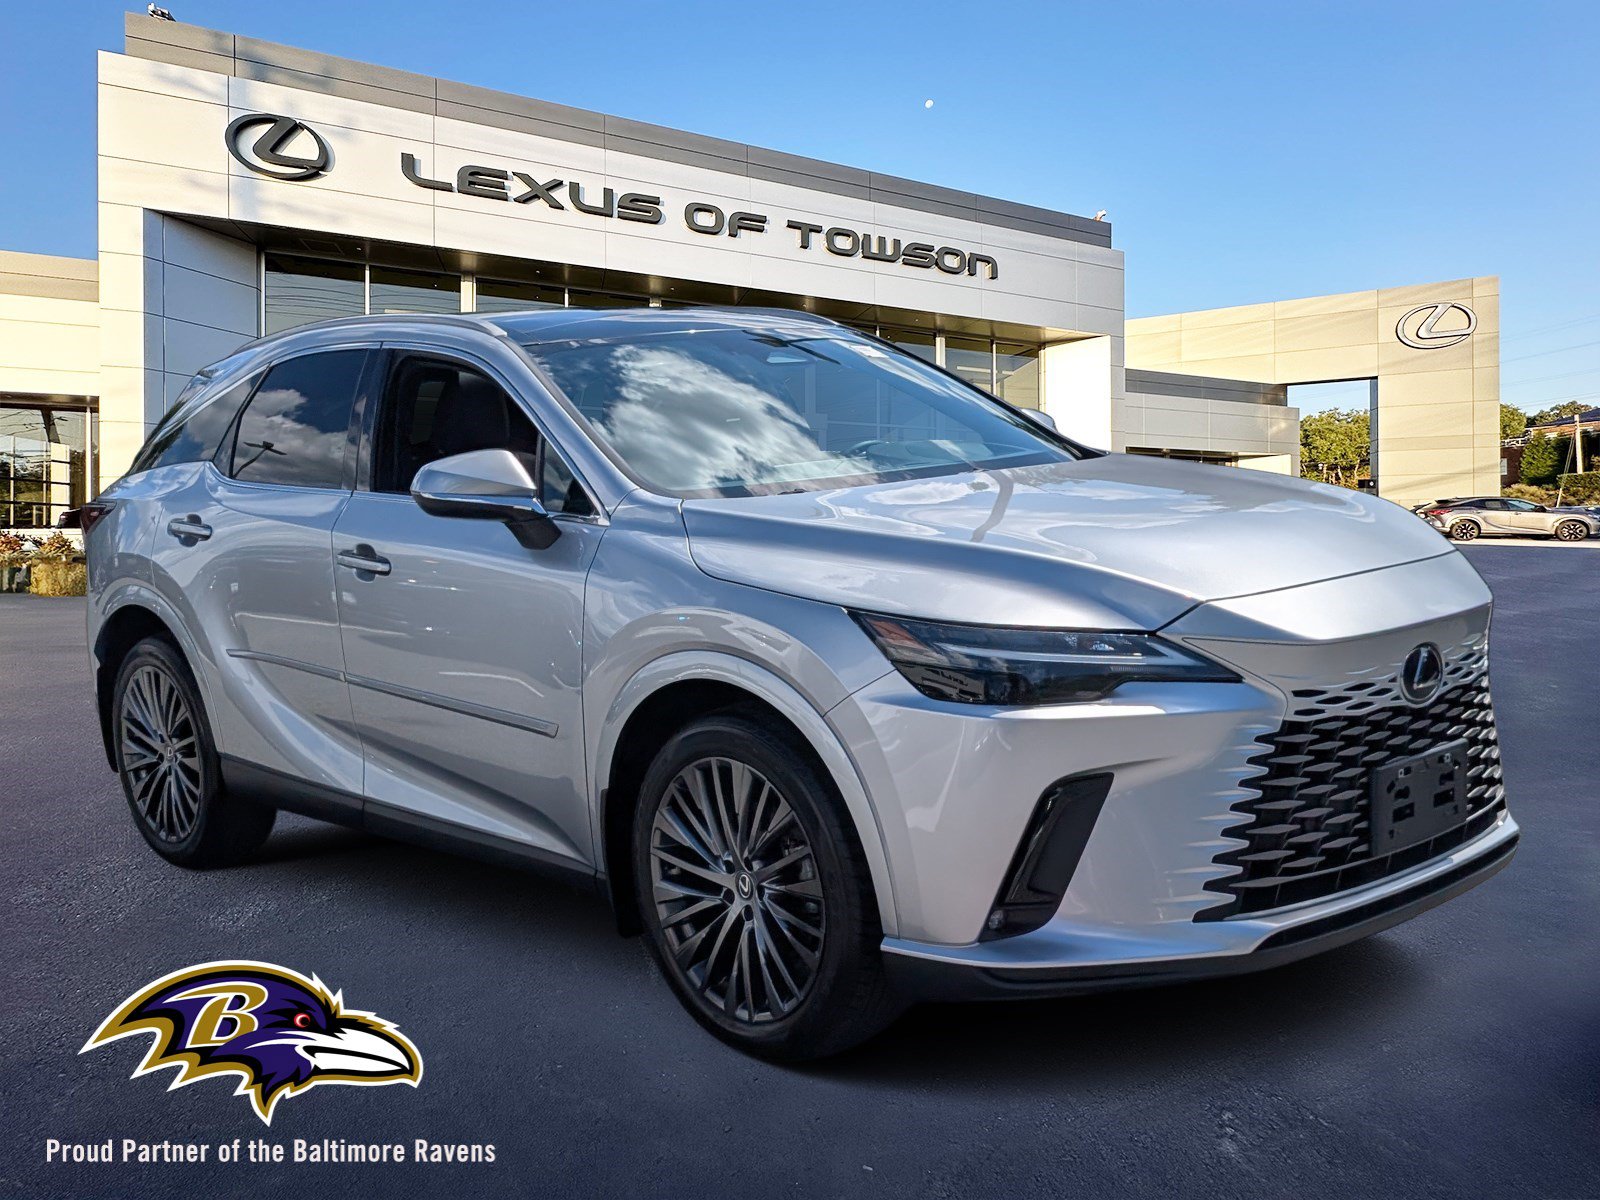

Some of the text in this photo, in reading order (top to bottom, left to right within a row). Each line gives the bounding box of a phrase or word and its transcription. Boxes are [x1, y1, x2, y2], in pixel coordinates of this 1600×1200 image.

[401, 152, 998, 280] LEXUS OF TOWSON
